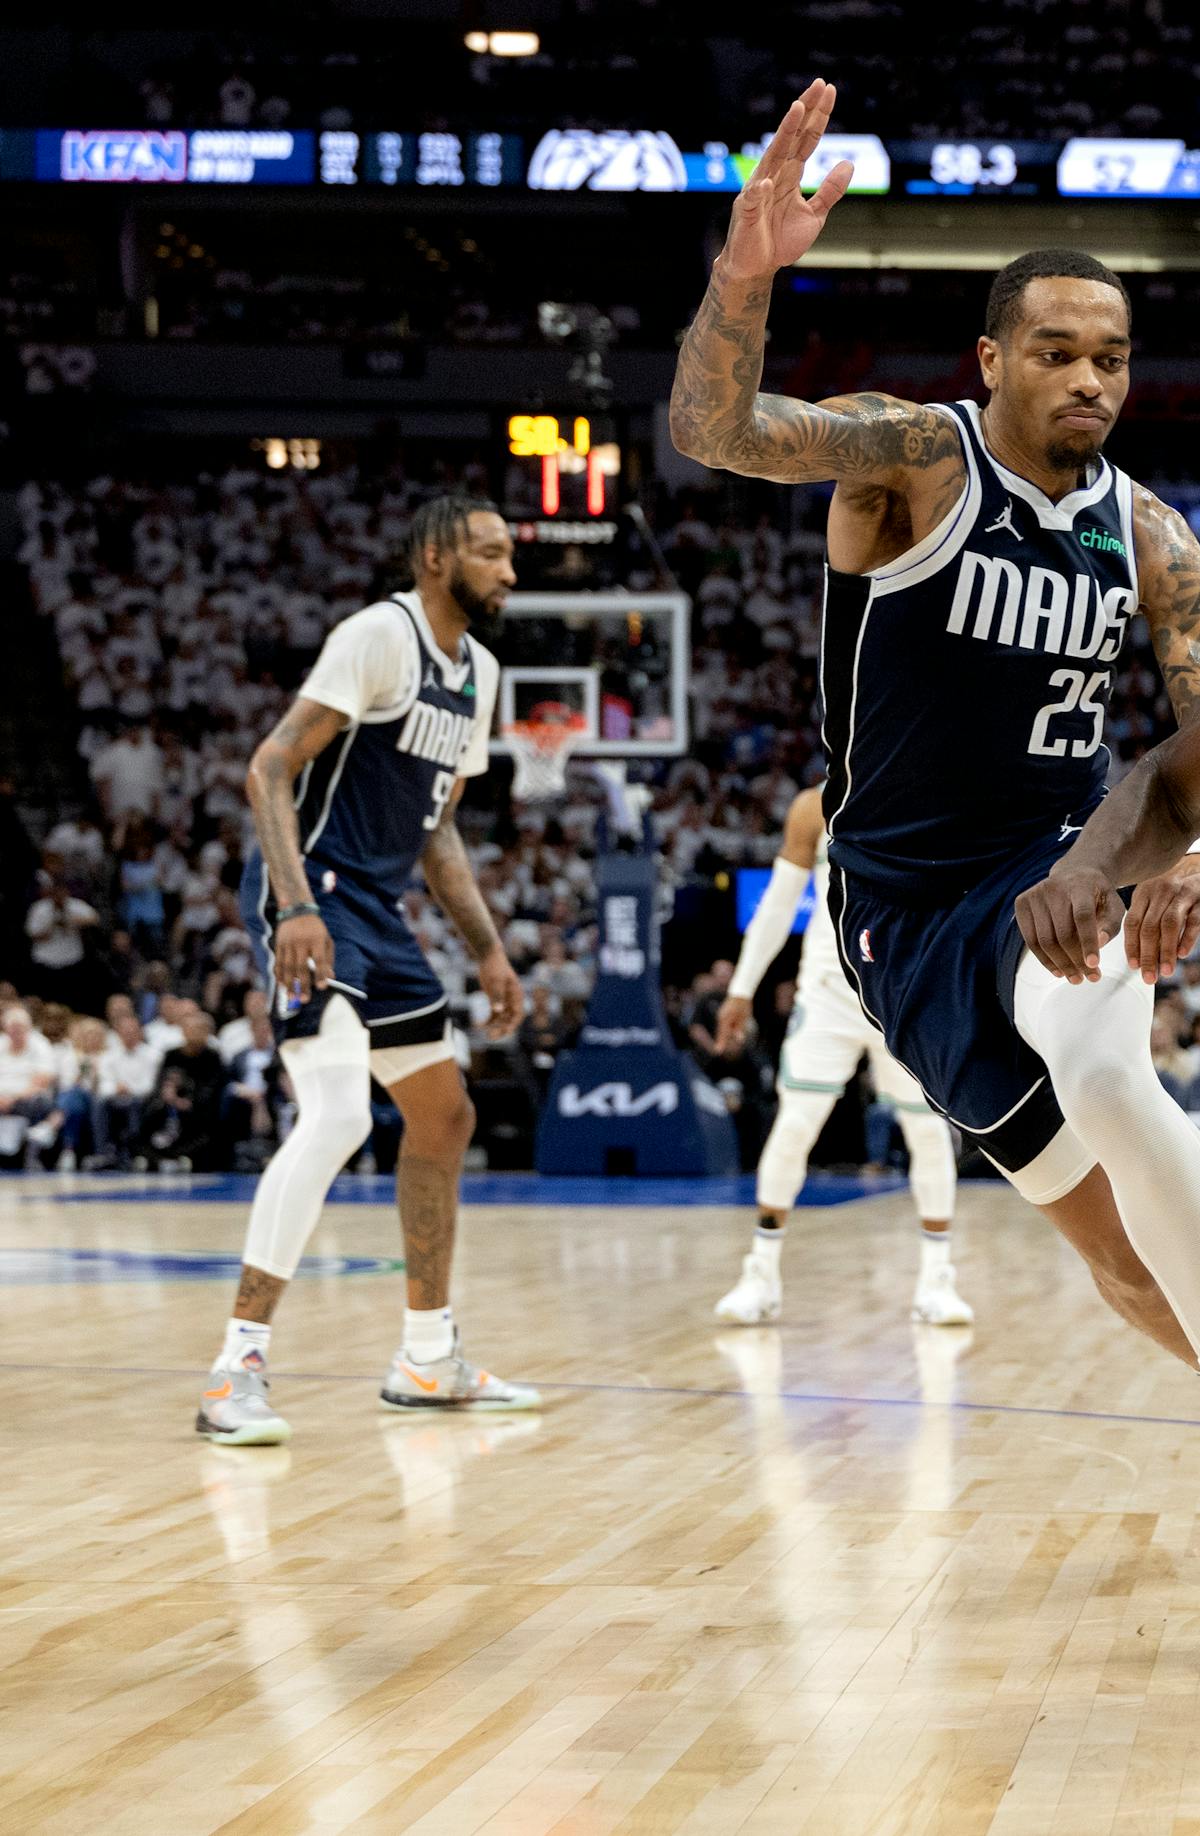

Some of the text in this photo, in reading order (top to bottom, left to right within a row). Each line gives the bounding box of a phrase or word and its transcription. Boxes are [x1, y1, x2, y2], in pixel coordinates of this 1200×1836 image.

[64, 133, 186, 180] KFAN
[946, 550, 1136, 662] MAVS
[1027, 668, 1112, 758] 25
